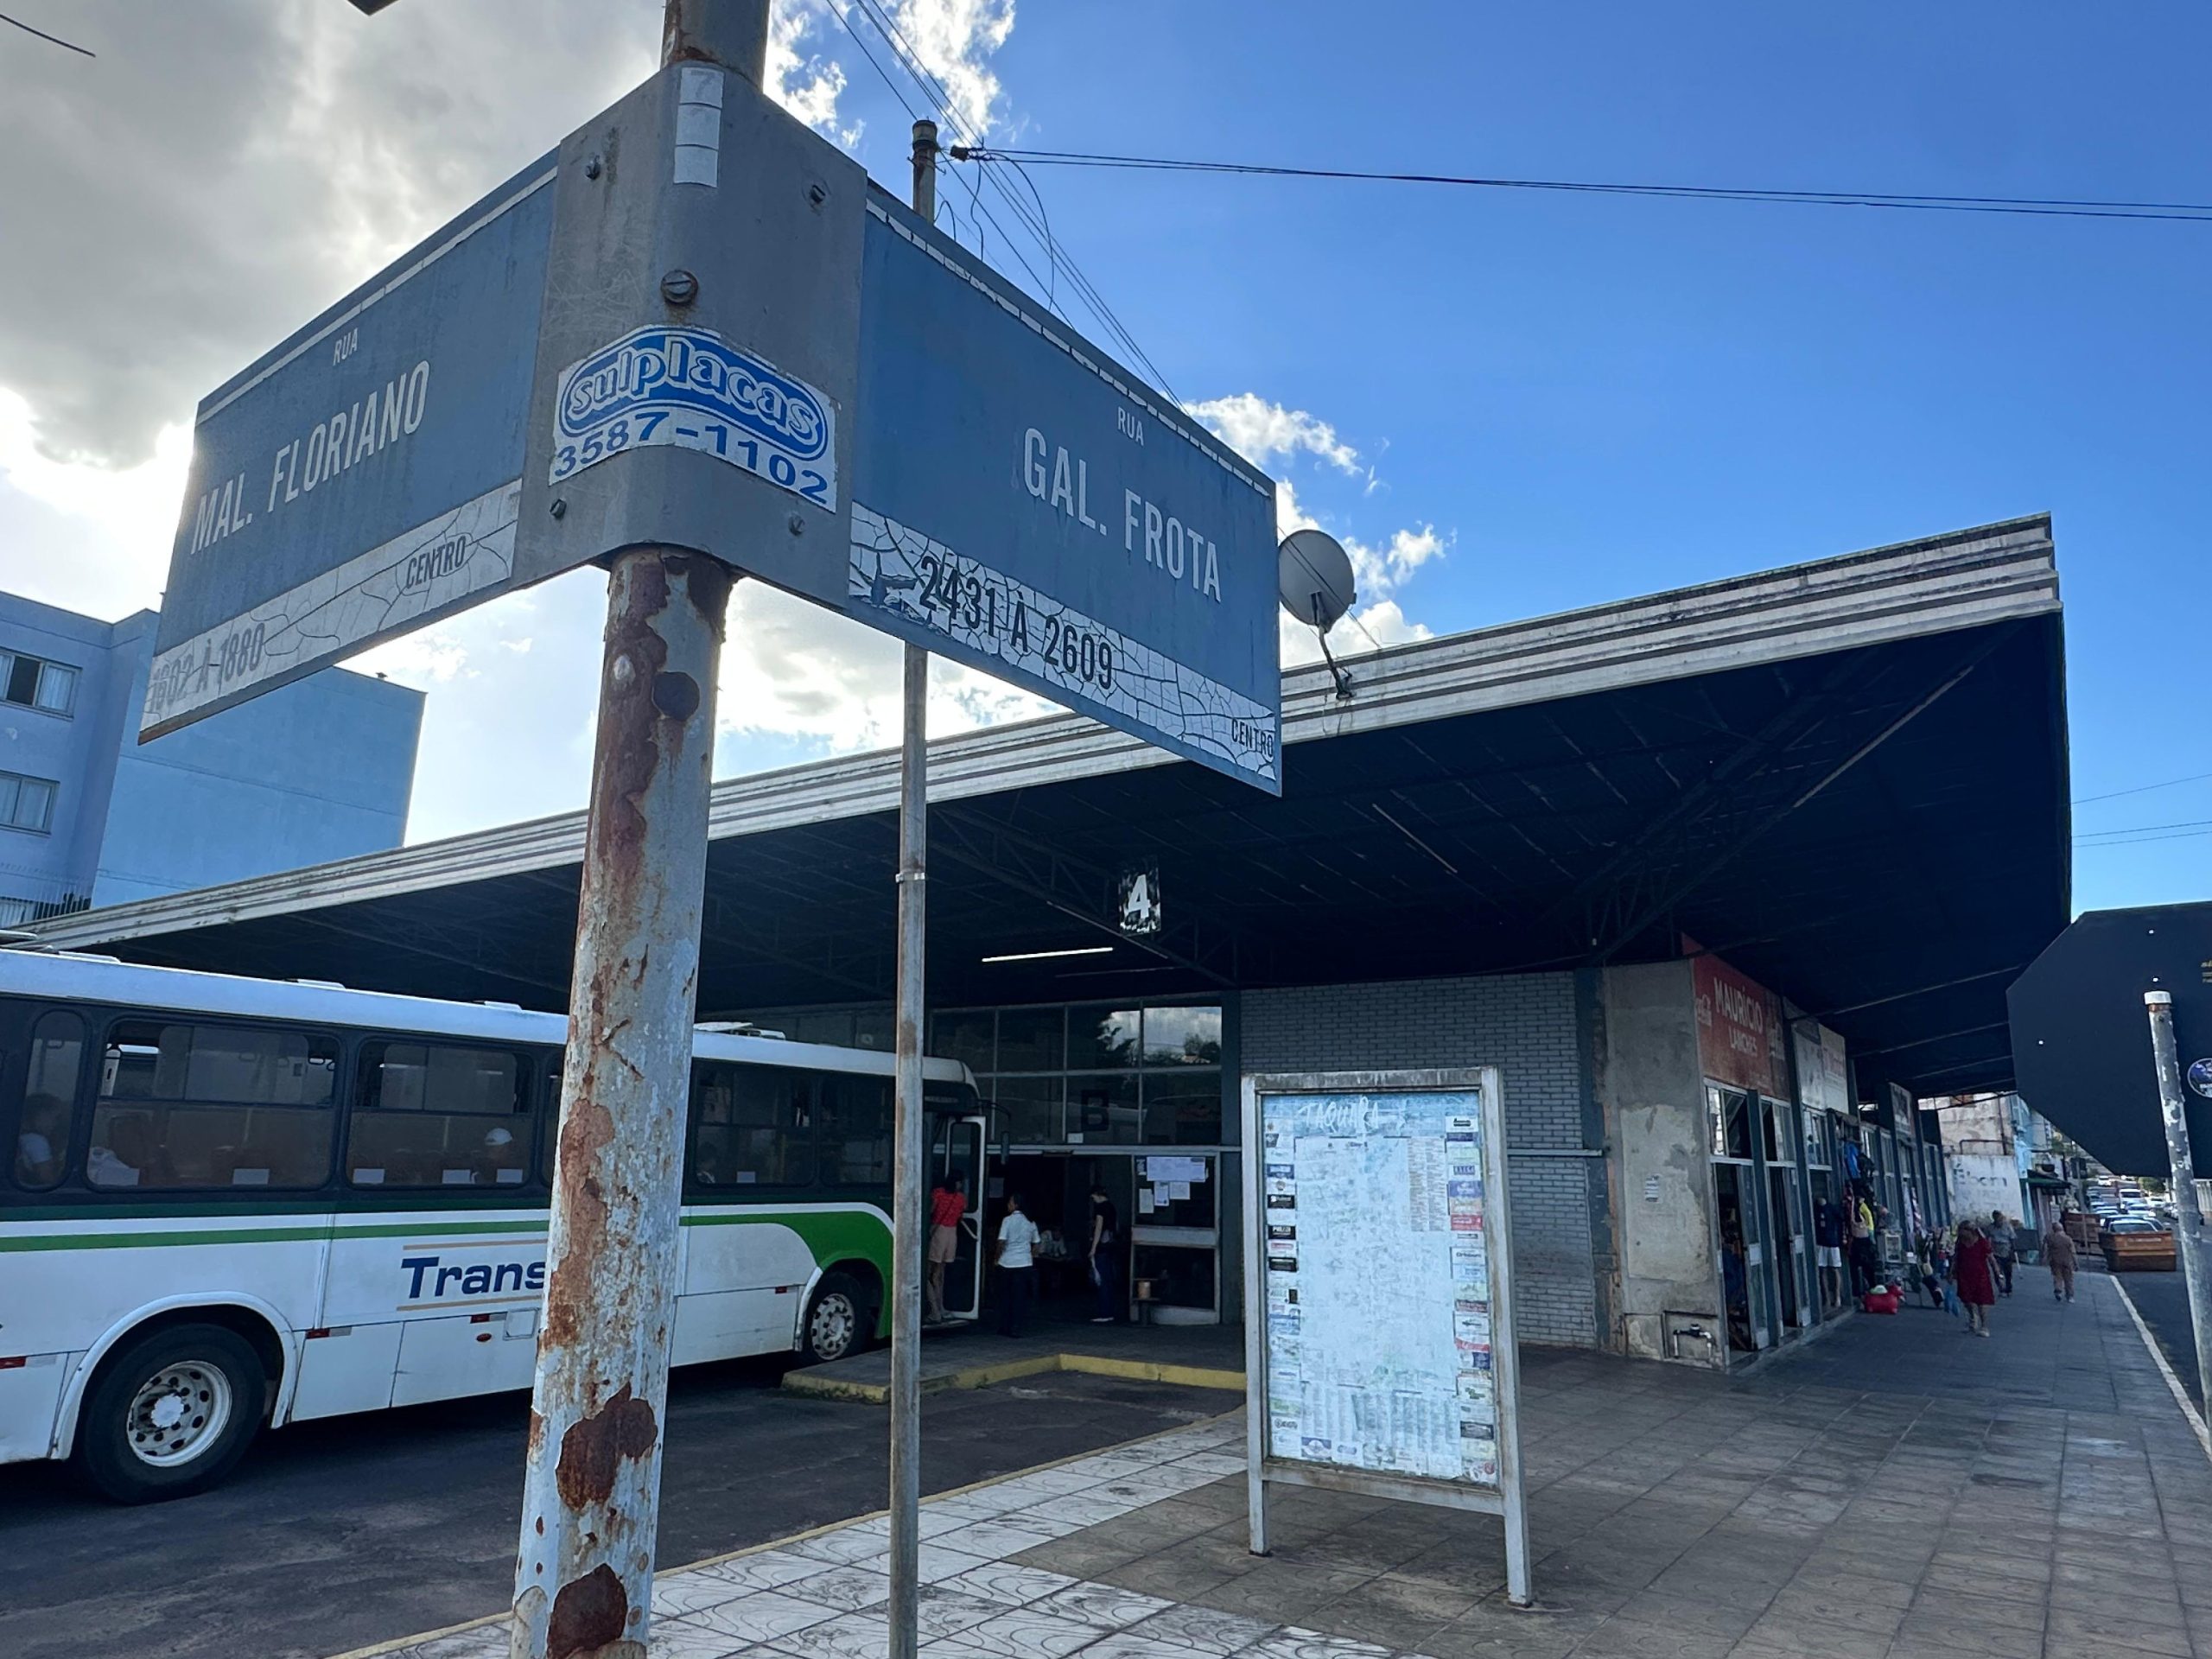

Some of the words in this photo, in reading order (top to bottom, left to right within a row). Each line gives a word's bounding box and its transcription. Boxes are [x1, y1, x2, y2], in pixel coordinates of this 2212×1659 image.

[333, 327, 359, 365] RUA
[566, 339, 820, 446] sulplacas
[1117, 406, 1145, 447] RUA
[190, 474, 253, 556] MAL.
[267, 359, 431, 513] FLORIANO
[555, 410, 830, 505] 3587-1102
[1023, 428, 1108, 537] GAL.
[1124, 488, 1223, 603] FROTA
[404, 535, 467, 589] CENTRO
[919, 556, 995, 637] 2431
[1044, 616, 1113, 690] 2609
[218, 623, 265, 684] 1880
[1230, 718, 1274, 758] CENTRO
[1127, 874, 1152, 920] 4
[1713, 976, 1764, 1035] MAURÍCIO
